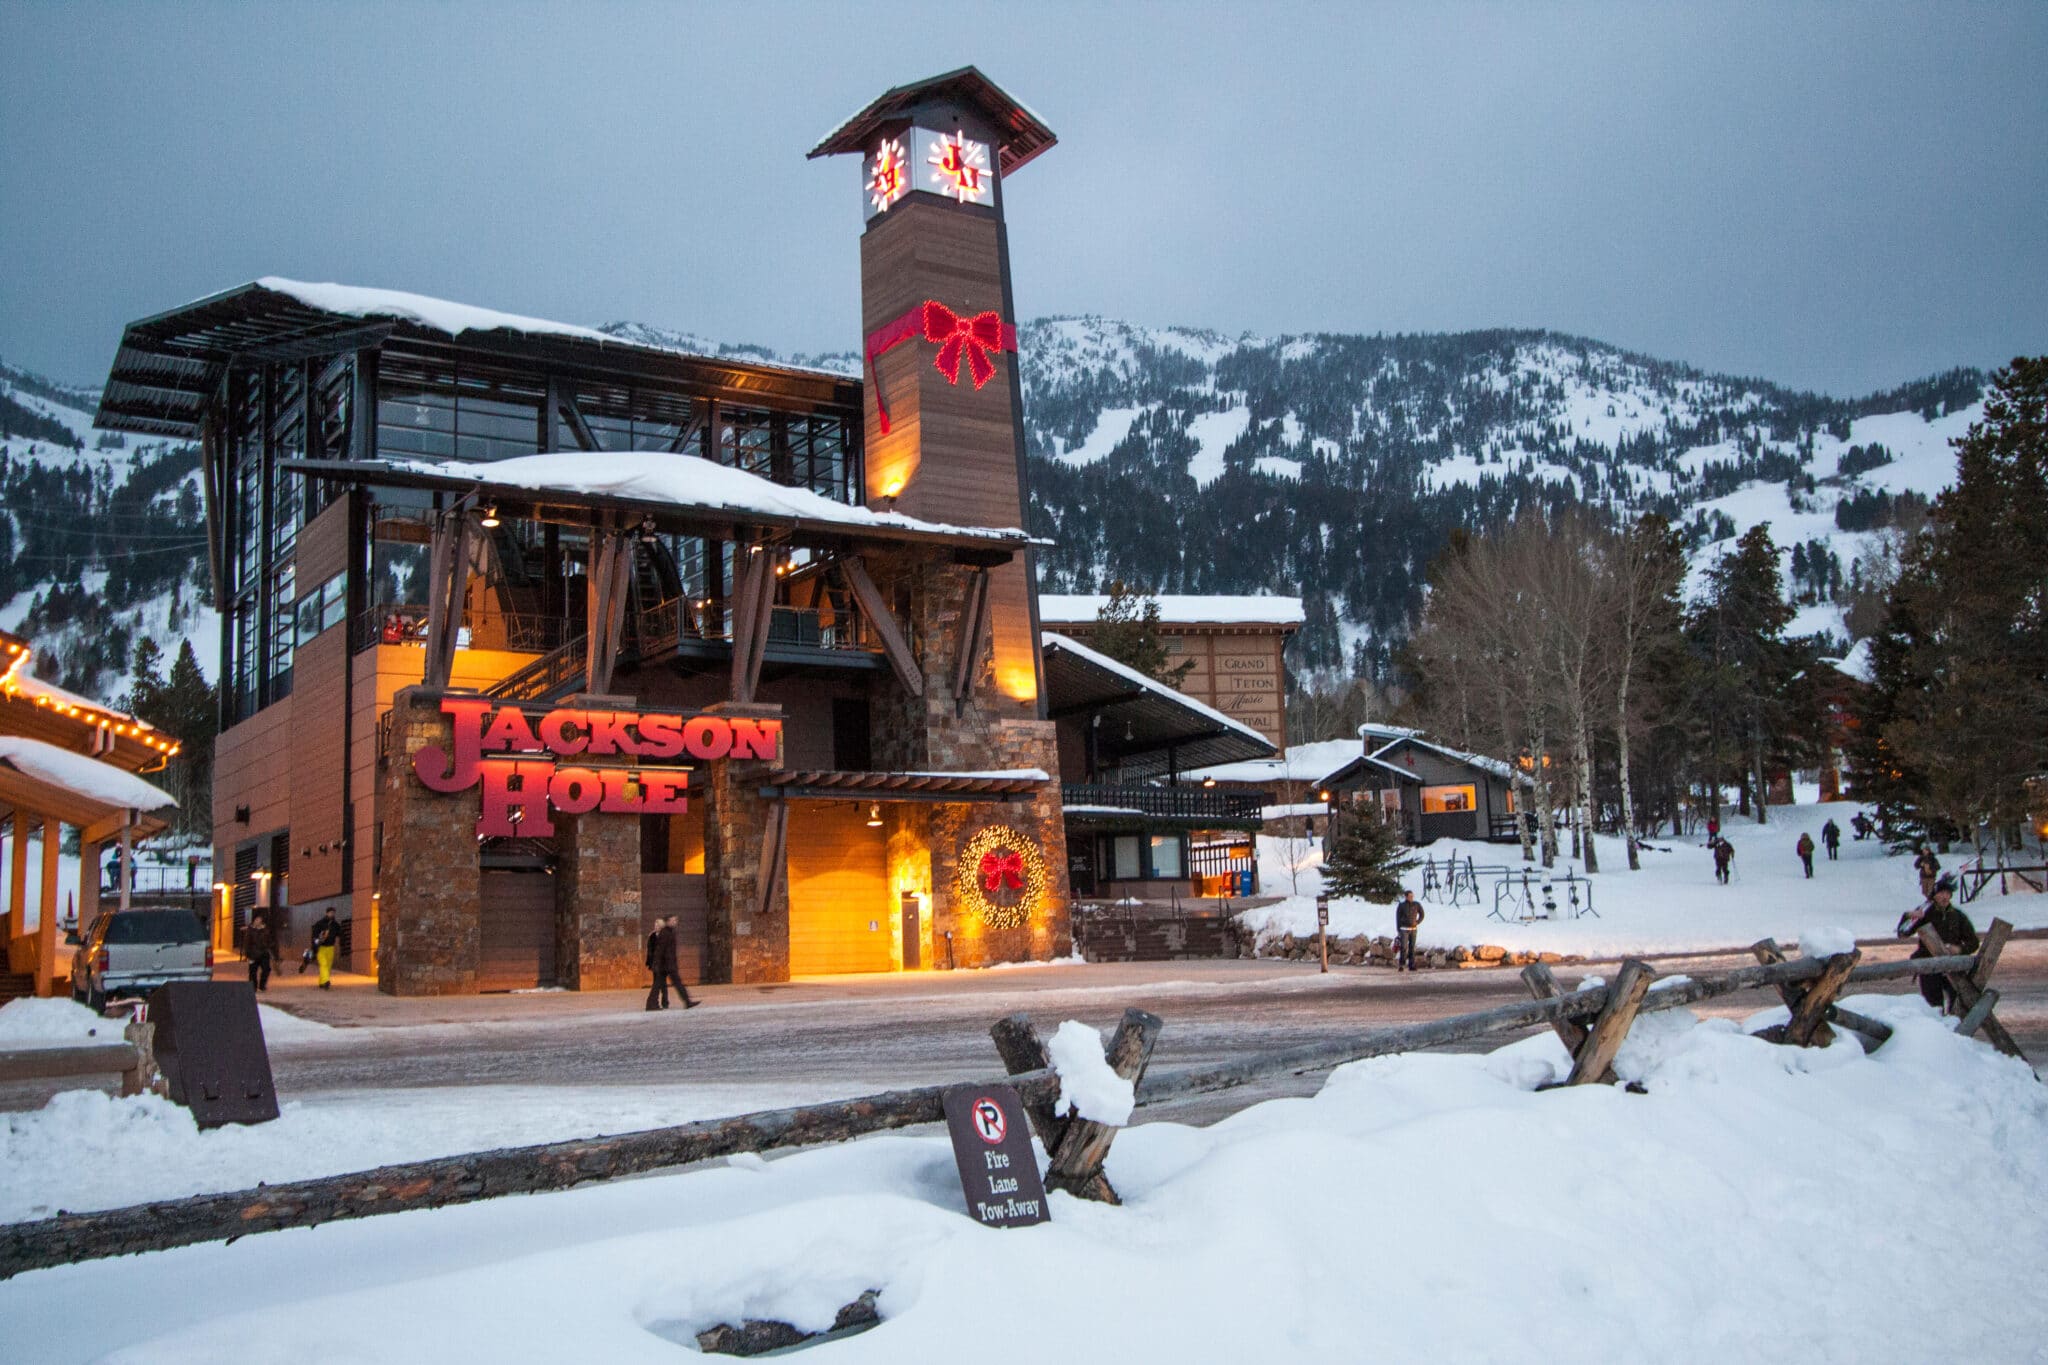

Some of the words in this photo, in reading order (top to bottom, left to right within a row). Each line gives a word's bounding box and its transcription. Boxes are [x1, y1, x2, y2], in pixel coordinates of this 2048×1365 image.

[1224, 659, 1264, 669] GRAND
[1233, 677, 1274, 689] TETON
[1241, 717, 1269, 727] TIVAL
[413, 698, 782, 793] JACKSON
[476, 760, 688, 838] HOLE
[985, 1151, 1010, 1169] Fire
[989, 1175, 1018, 1194] Lane
[978, 1199, 1039, 1221] Tow-Away
